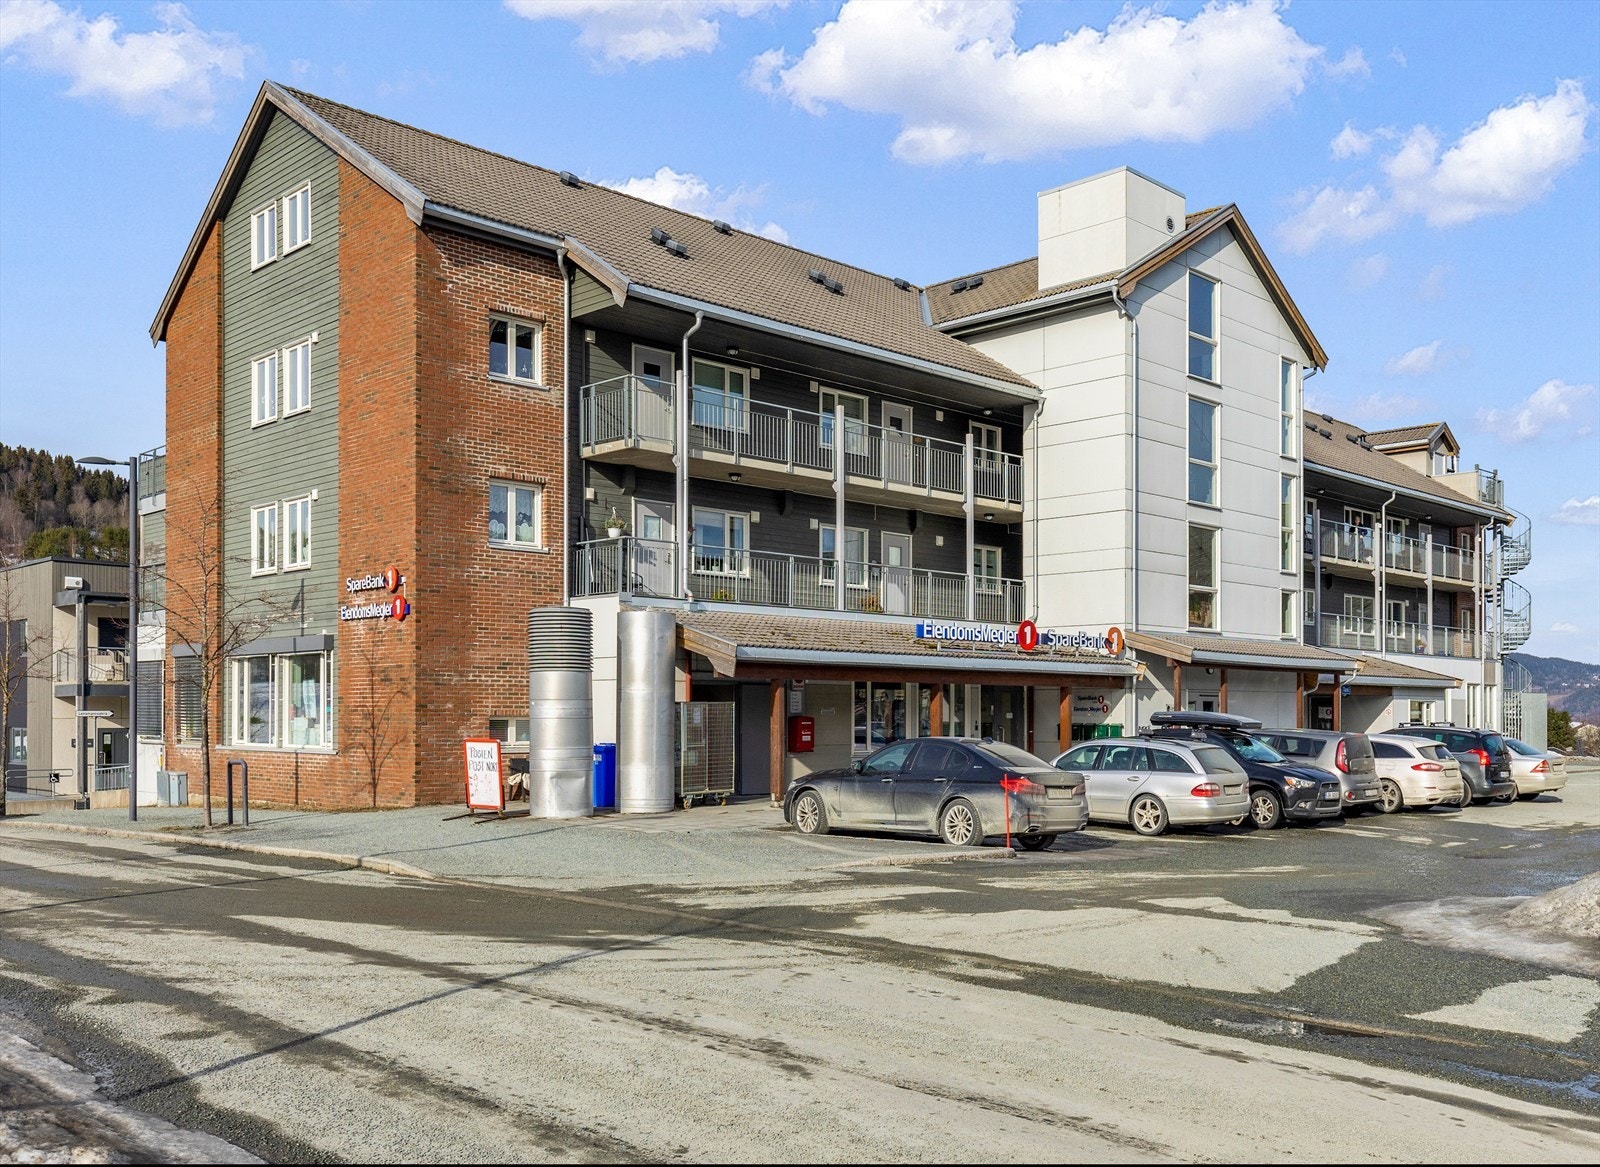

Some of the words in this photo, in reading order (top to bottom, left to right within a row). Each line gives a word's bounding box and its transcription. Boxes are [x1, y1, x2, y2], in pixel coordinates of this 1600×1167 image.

[346, 573, 385, 593] SpareBank
[341, 602, 393, 619] EiendomsMegler
[923, 620, 1018, 647] EiendomsMegler
[1047, 629, 1106, 650] SpareBank
[468, 759, 484, 772] POST
